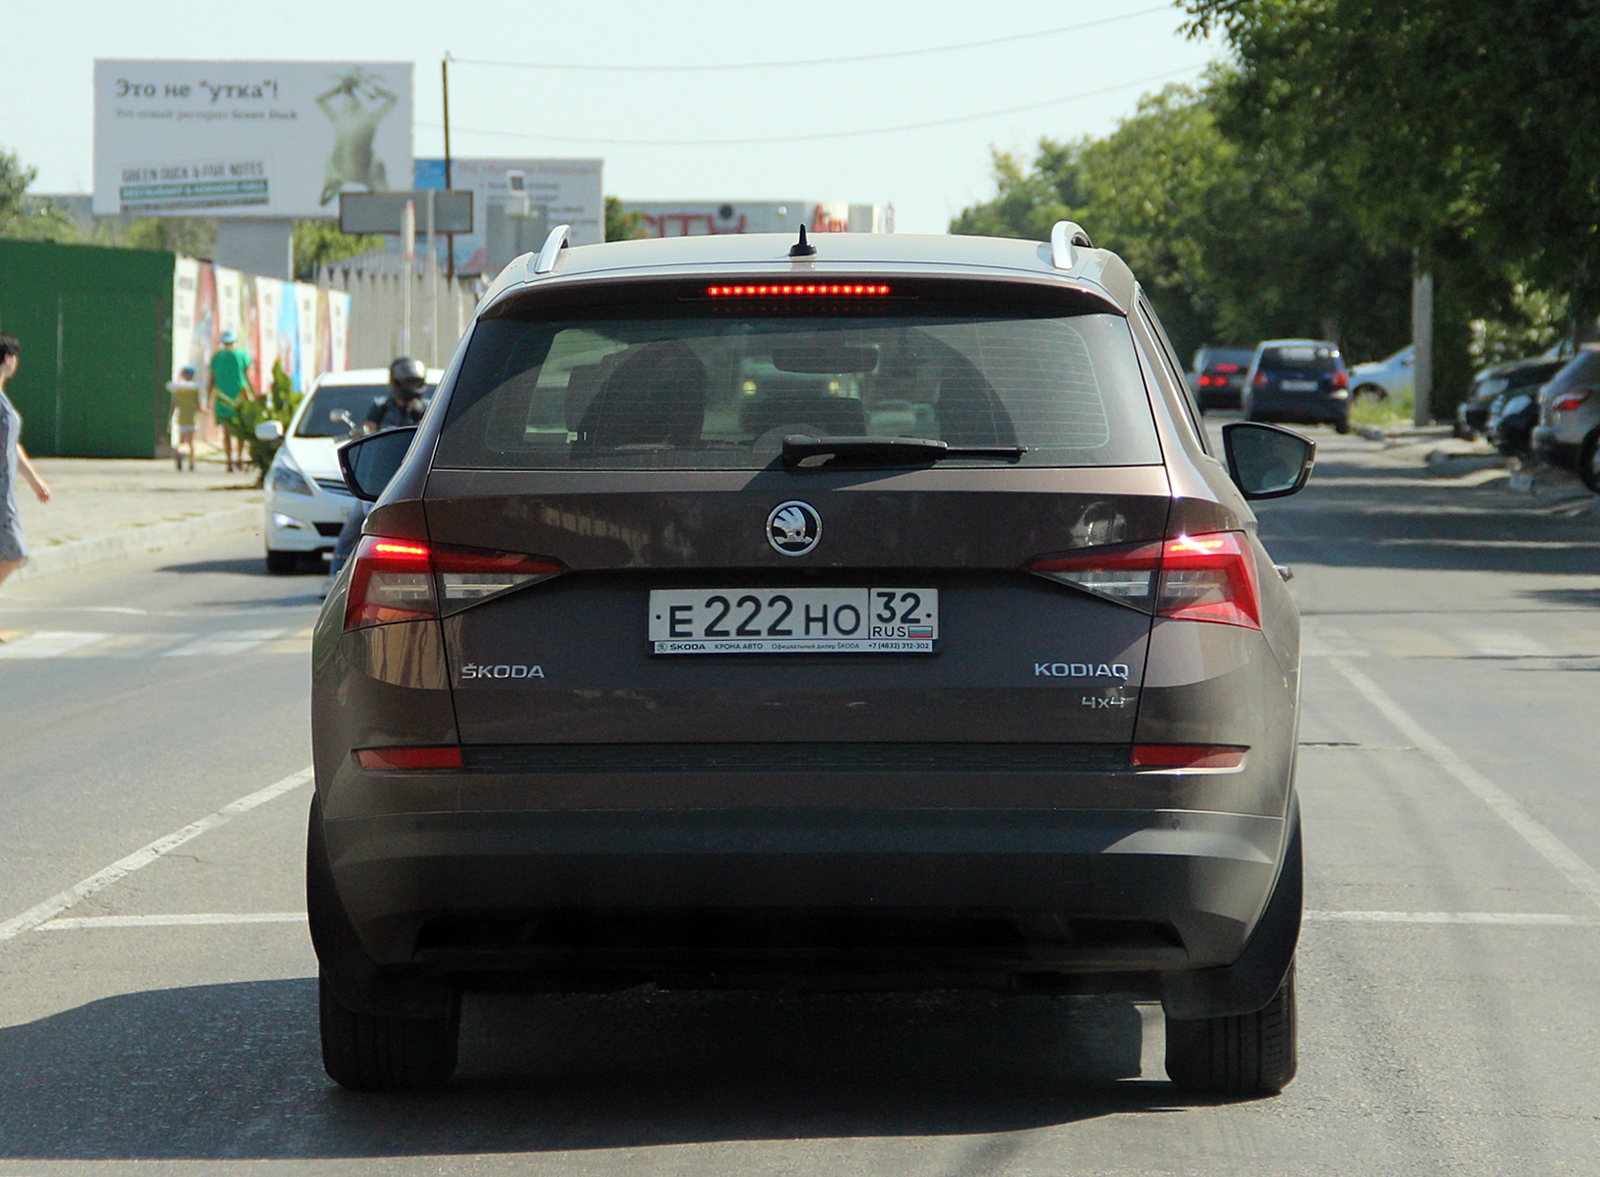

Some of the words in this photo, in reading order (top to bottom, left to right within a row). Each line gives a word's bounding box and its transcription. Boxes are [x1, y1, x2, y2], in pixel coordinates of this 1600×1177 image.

[116, 78, 156, 98] Это
[164, 83, 191, 97] не
[876, 592, 921, 624] 32
[872, 626, 907, 637] RUS
[461, 662, 545, 679] ŠKODA
[1034, 662, 1130, 681] KODIAQ
